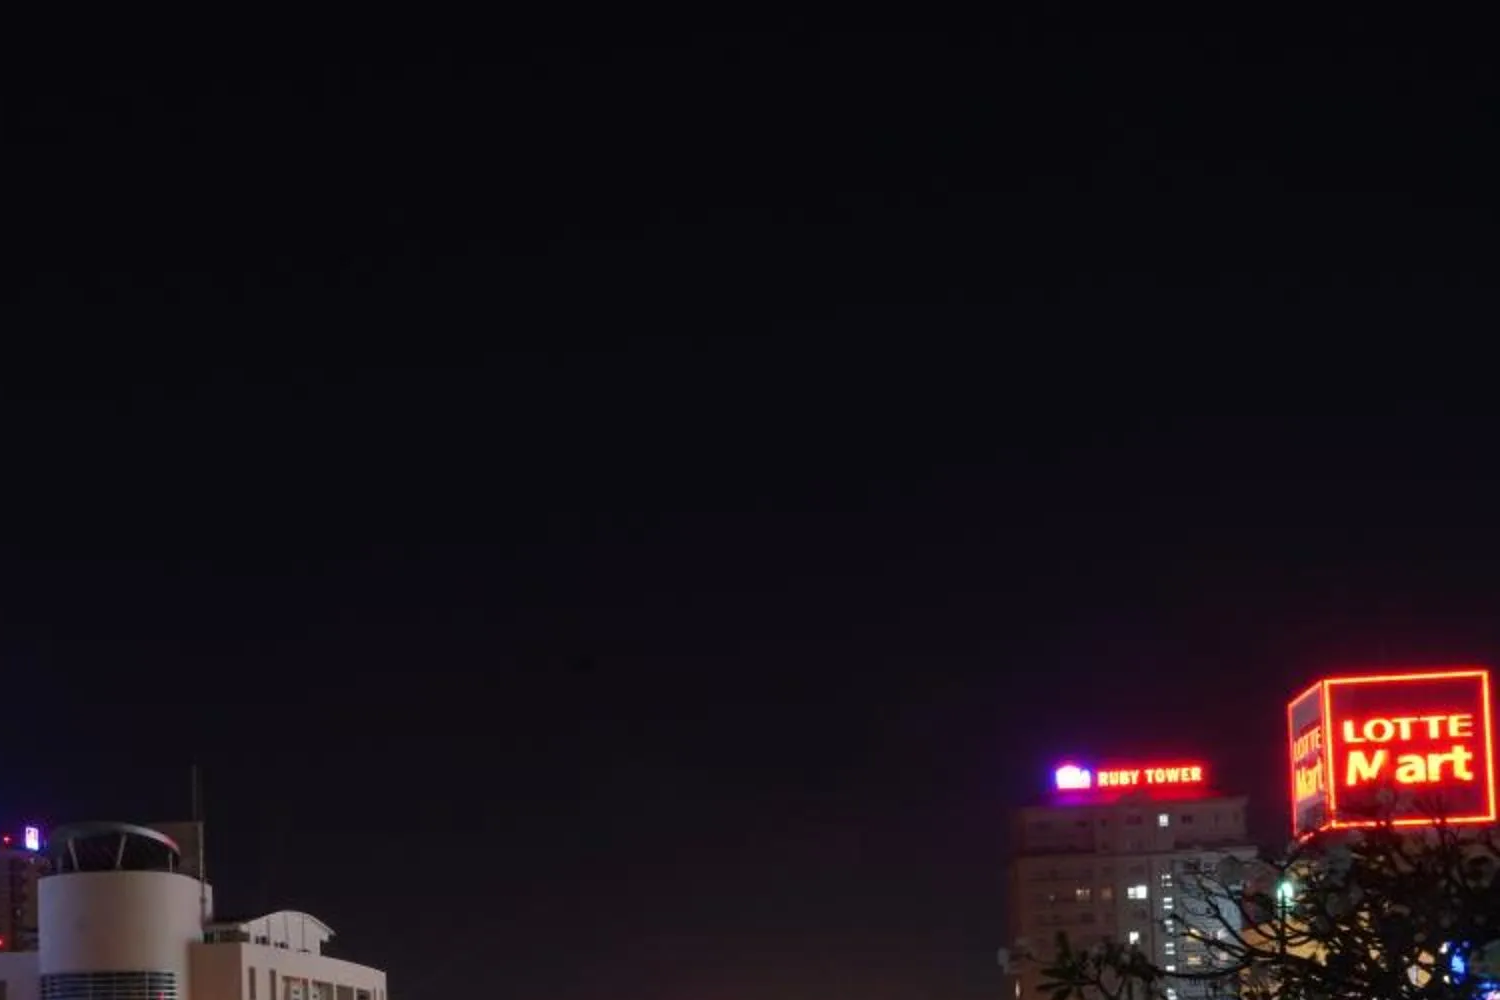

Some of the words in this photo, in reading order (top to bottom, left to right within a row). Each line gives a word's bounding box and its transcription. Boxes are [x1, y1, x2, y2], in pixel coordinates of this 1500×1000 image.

[1343, 715, 1473, 743] LOTTE
[1098, 770, 1140, 787] RUBY
[1145, 767, 1202, 784] TOWER
[1347, 744, 1473, 786] Mart
